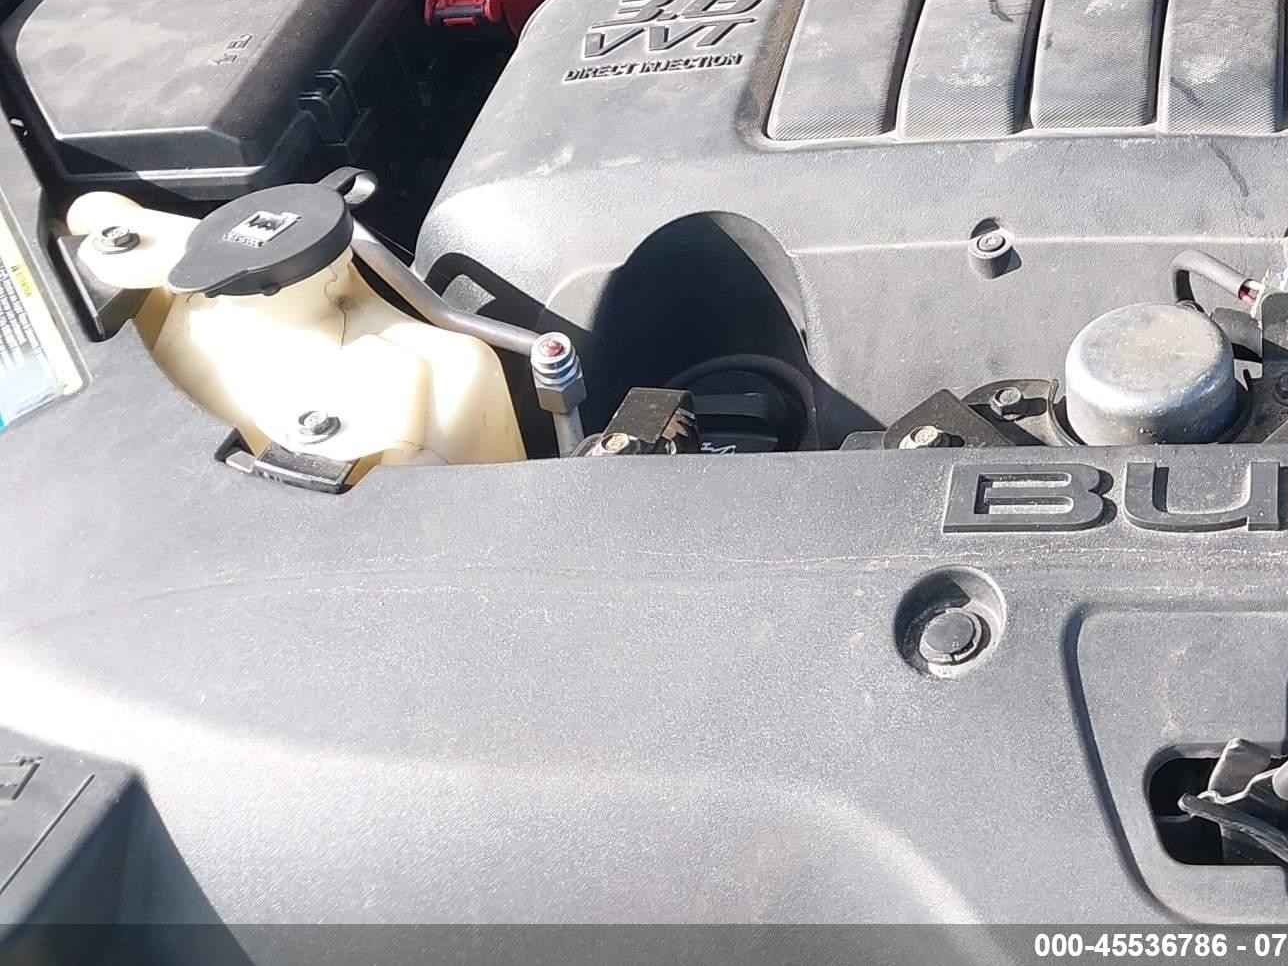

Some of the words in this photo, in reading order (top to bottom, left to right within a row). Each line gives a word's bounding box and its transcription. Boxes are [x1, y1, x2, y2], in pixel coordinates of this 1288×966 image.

[584, 17, 758, 58] VVT
[565, 62, 637, 82] DIRECT
[640, 52, 744, 73] INJECTION
